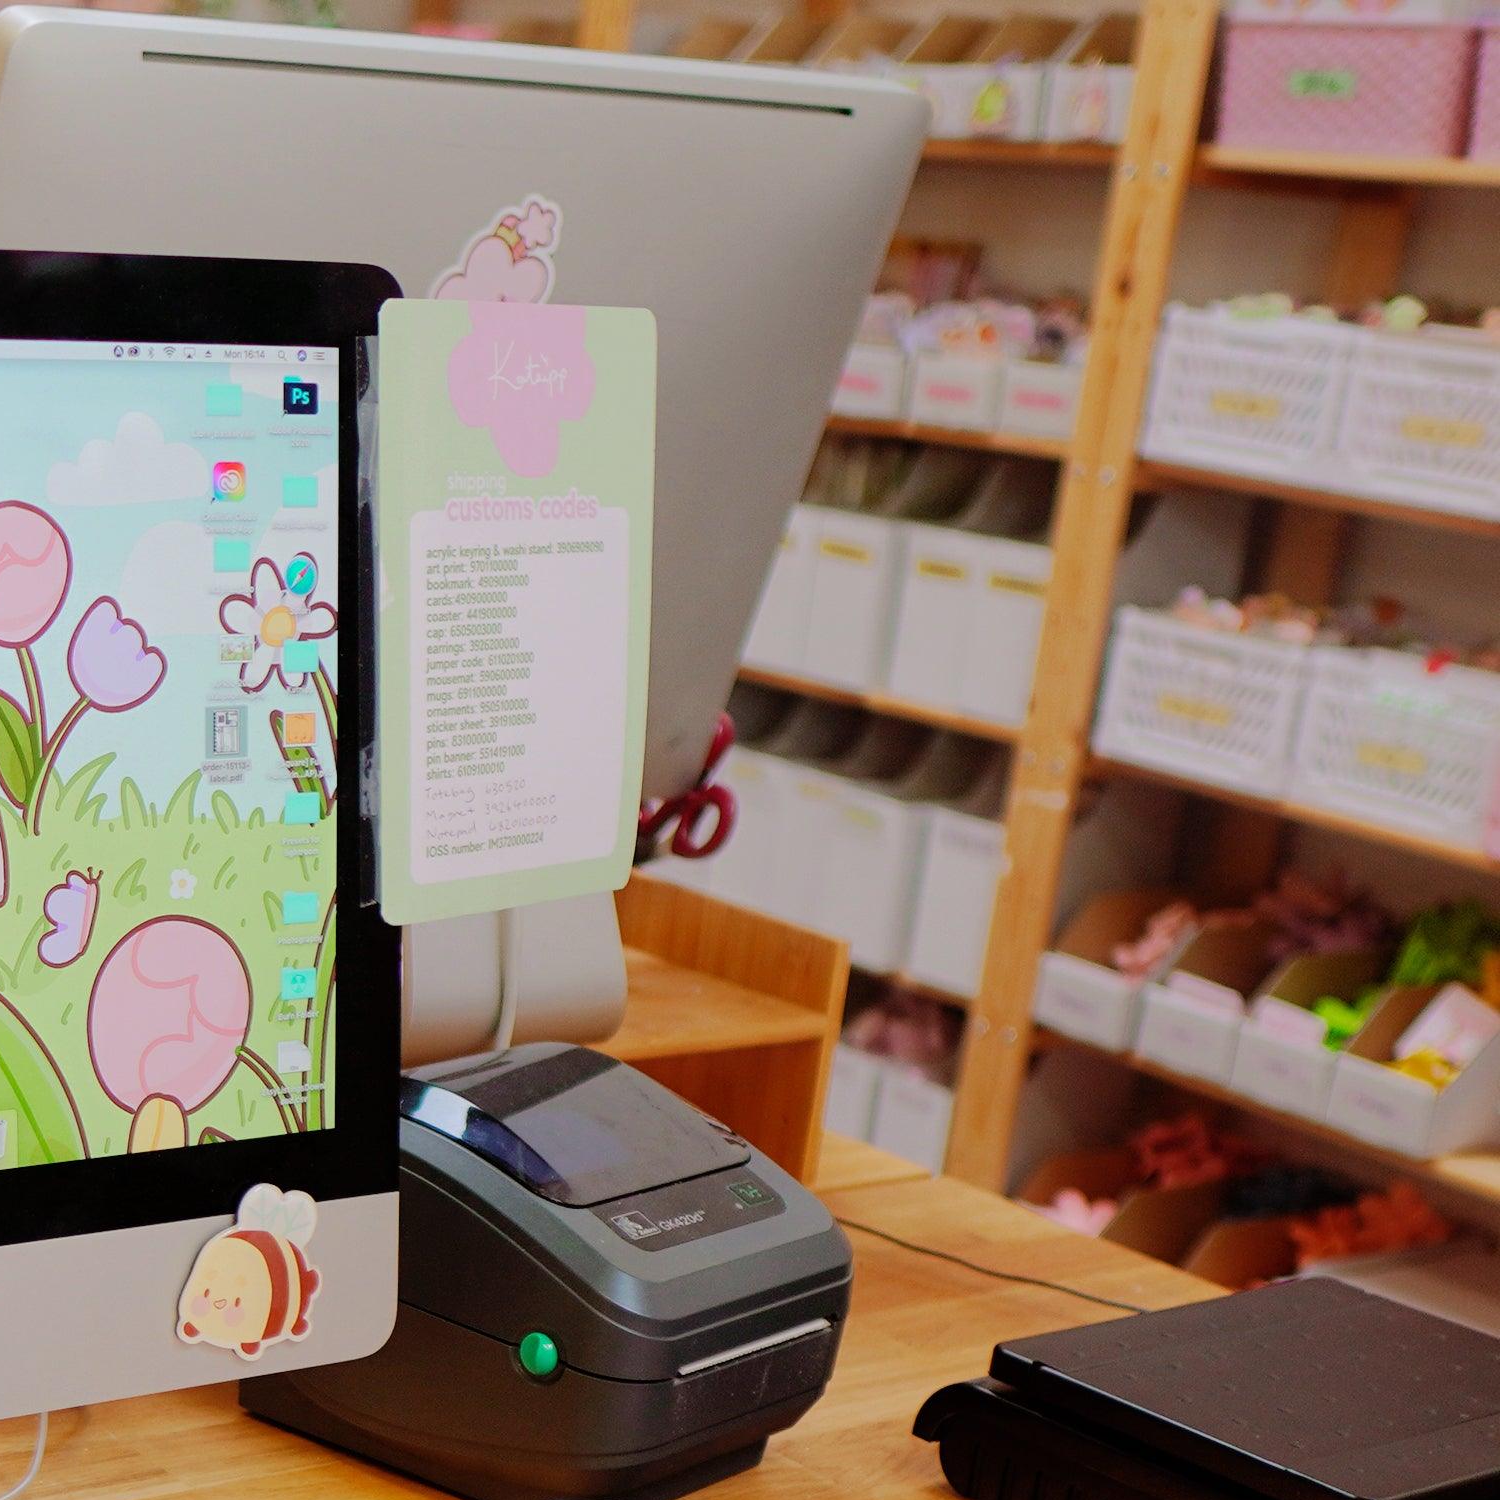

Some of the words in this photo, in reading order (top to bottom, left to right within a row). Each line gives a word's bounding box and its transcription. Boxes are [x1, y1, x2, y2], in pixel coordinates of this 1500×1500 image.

[292, 388, 310, 405] Ps
[446, 471, 507, 495] shipping
[446, 498, 533, 521] customs
[539, 490, 598, 520] codes
[426, 545, 457, 560] acrylic
[460, 545, 491, 560] keyring
[426, 565, 440, 575] art
[426, 659, 459, 674] jumper
[426, 721, 458, 734] sticker
[426, 755, 441, 768] pin
[426, 844, 449, 858] IOSS
